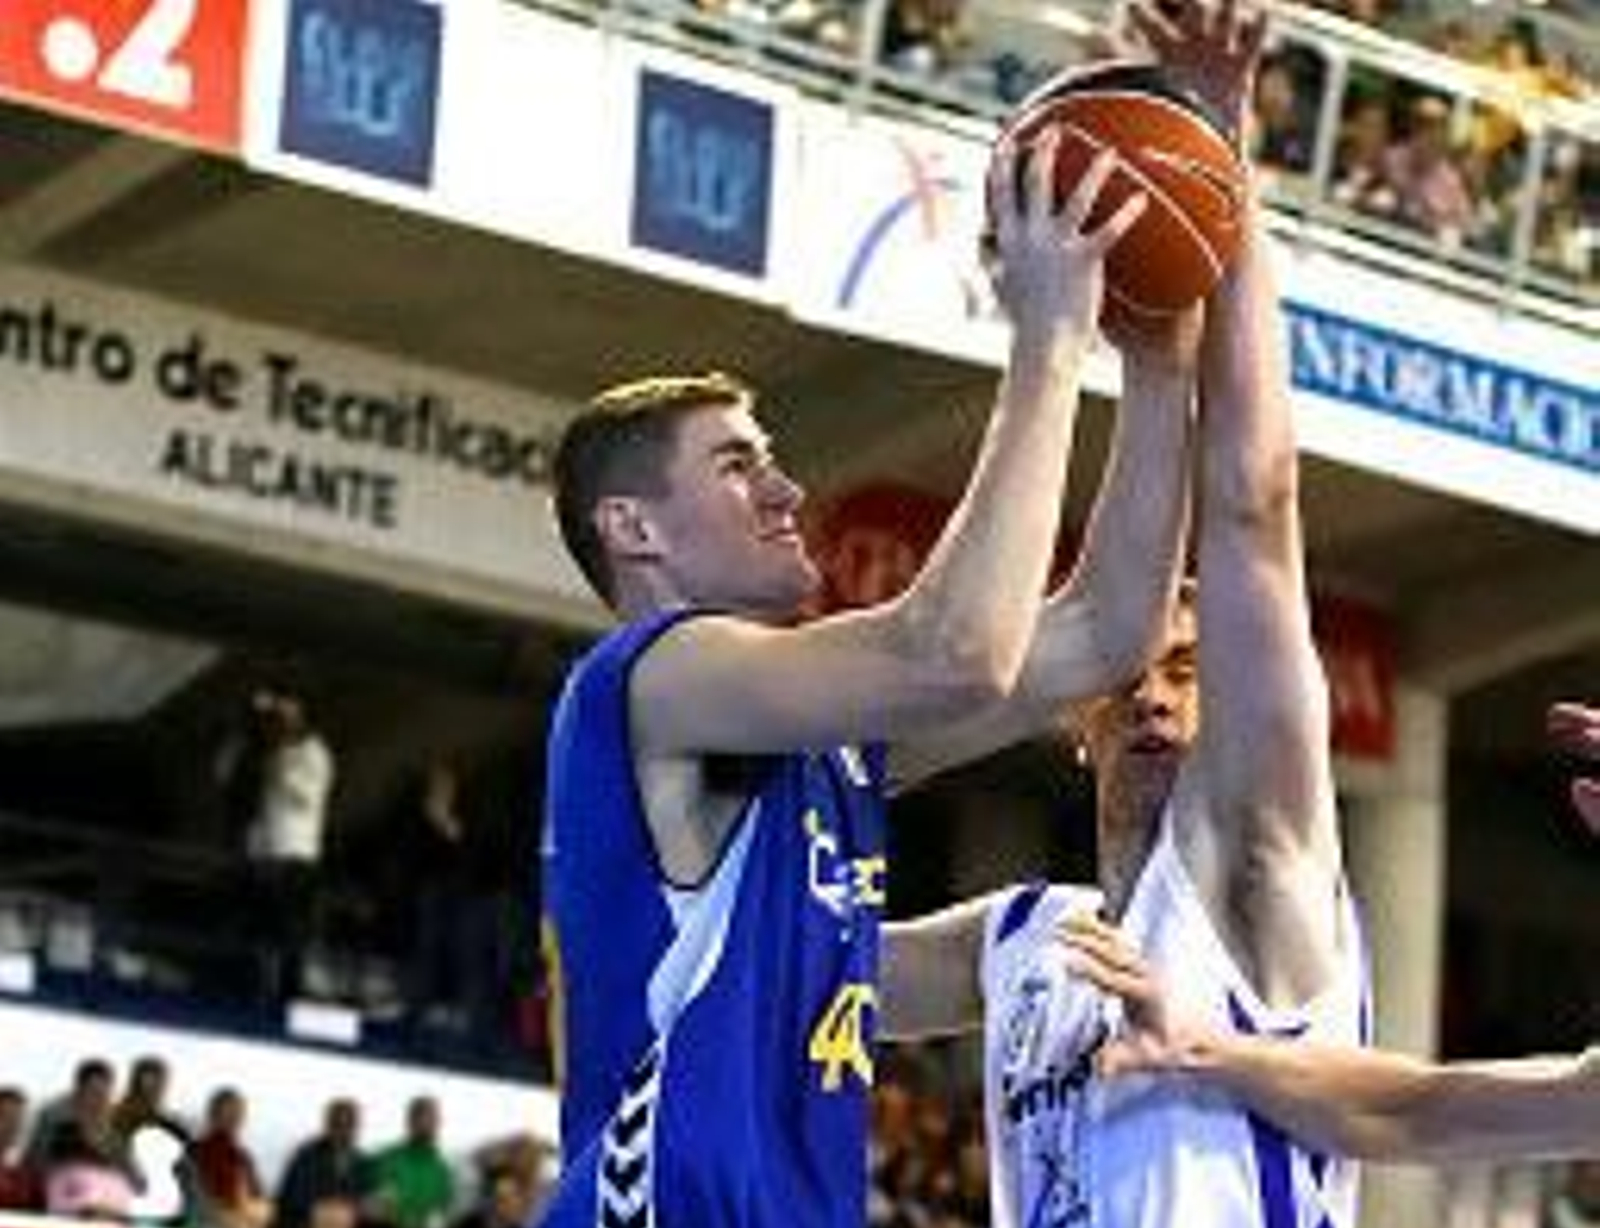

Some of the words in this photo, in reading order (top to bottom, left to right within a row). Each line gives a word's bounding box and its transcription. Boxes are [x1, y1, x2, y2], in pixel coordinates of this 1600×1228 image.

[157, 334, 243, 410] de
[1289, 314, 1600, 462] NFORMACI
[161, 430, 400, 528] ALICANTE
